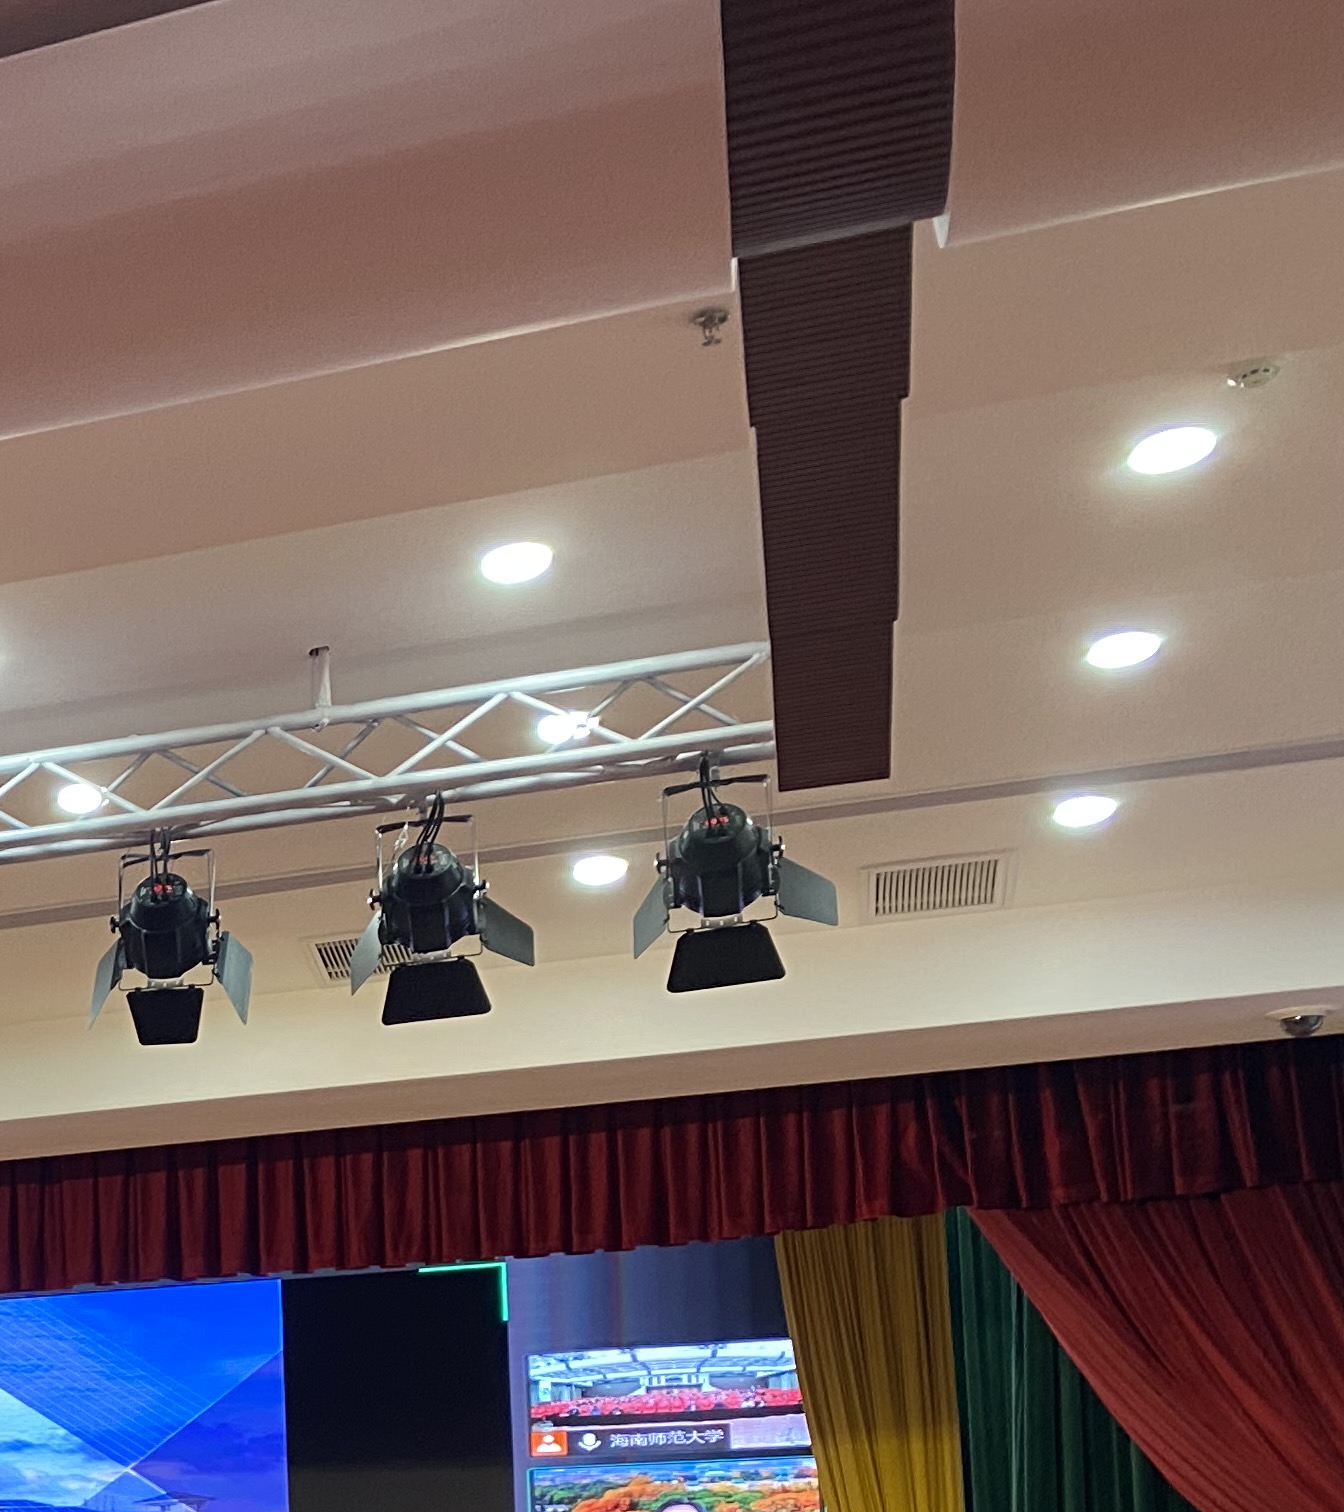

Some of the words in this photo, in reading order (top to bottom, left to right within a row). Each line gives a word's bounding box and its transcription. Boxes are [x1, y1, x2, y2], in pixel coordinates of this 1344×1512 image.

[609, 1429, 725, 1449] 海南师范大学
